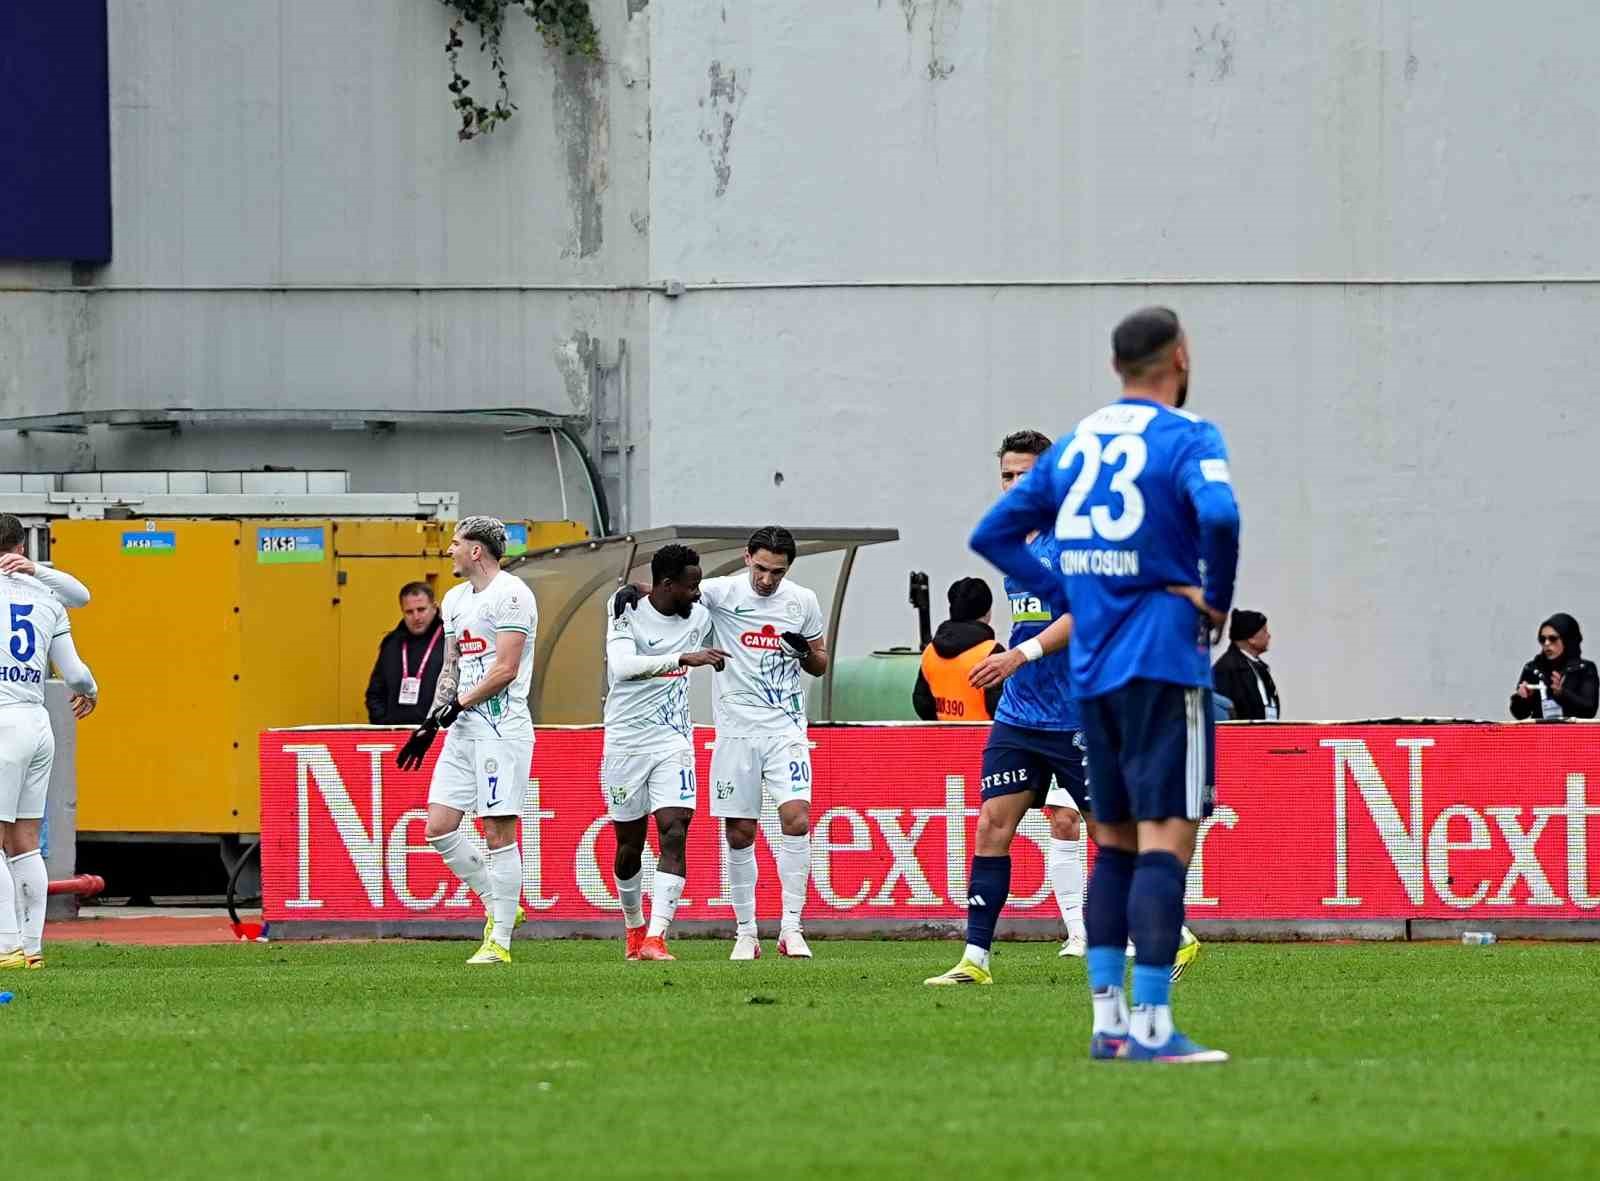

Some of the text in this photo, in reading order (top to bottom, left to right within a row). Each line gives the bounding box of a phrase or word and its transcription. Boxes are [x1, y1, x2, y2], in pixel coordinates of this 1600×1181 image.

[1055, 434, 1147, 541] 23
[263, 536, 296, 552] aksa
[1088, 550, 1139, 576] OSUN
[10, 603, 35, 662] 5
[679, 768, 695, 792] 10
[788, 761, 809, 783] 20
[488, 776, 499, 801] 7
